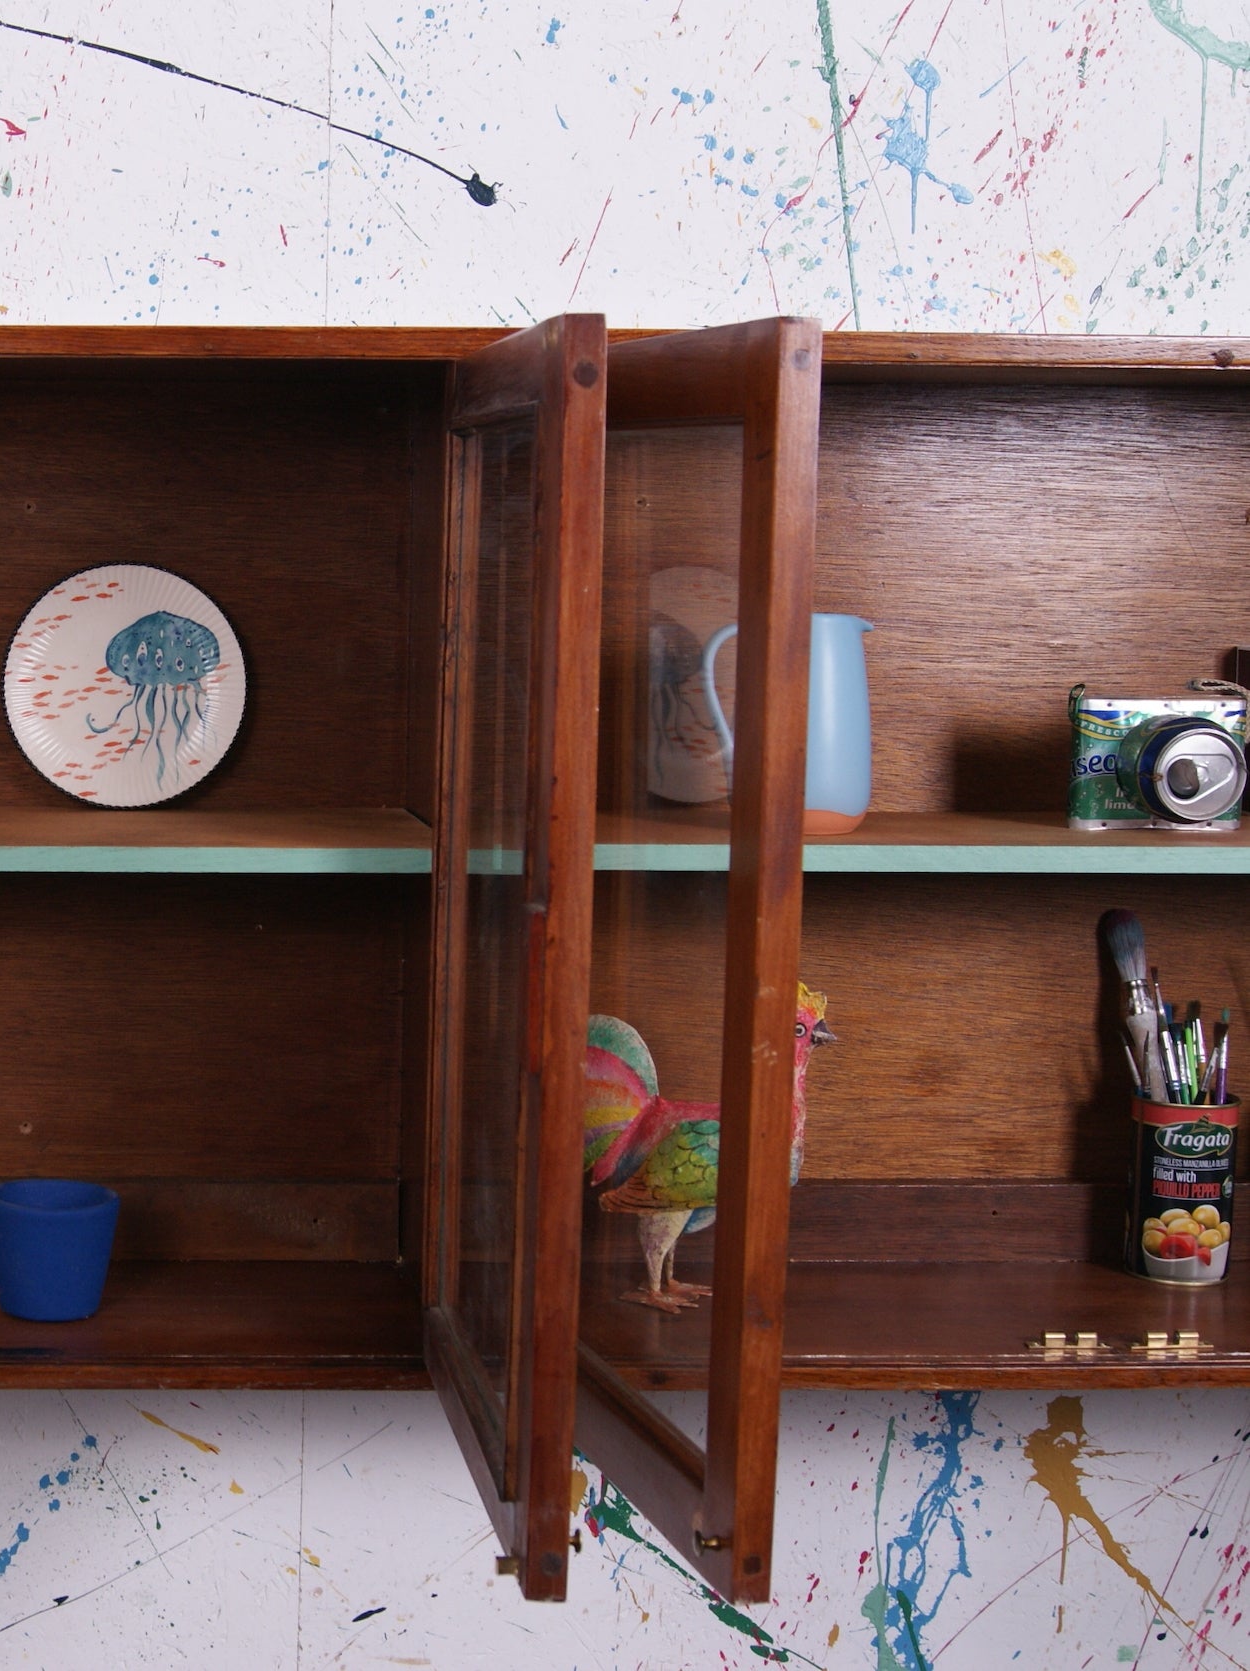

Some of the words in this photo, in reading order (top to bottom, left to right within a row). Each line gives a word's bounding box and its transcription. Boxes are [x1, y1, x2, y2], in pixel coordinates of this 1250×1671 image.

[1162, 1125, 1230, 1151] Fragata
[1153, 1156, 1183, 1166] STONELESS
[1183, 1159, 1215, 1167] MANZANILLA
[1153, 1166, 1174, 1181] filled
[1176, 1169, 1196, 1183] with
[1153, 1179, 1189, 1198] PIQUILLO
[1191, 1182, 1221, 1198] PEPPER
